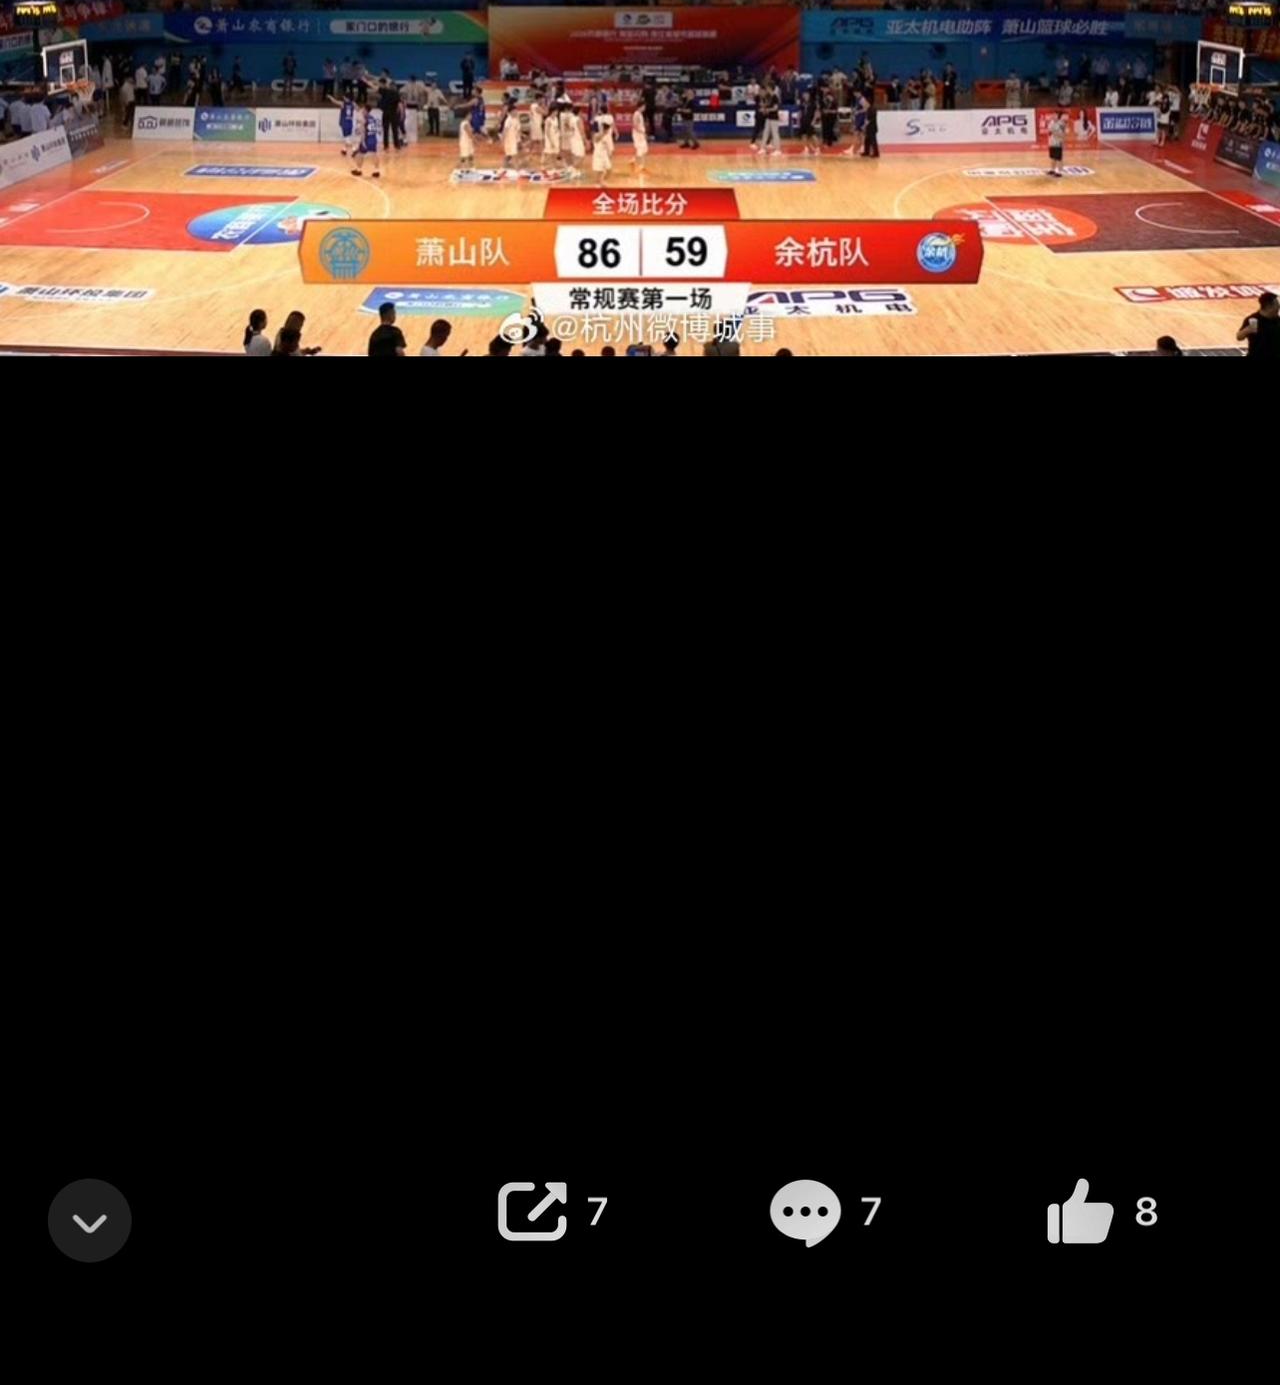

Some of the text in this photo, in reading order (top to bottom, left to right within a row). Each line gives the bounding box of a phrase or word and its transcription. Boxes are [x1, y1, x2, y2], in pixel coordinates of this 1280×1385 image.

[887, 19, 992, 35] 亚太机电助阵
[1001, 18, 1108, 35] 萧山篮球必胜
[982, 115, 1028, 127] APG
[746, 289, 907, 304] APG
